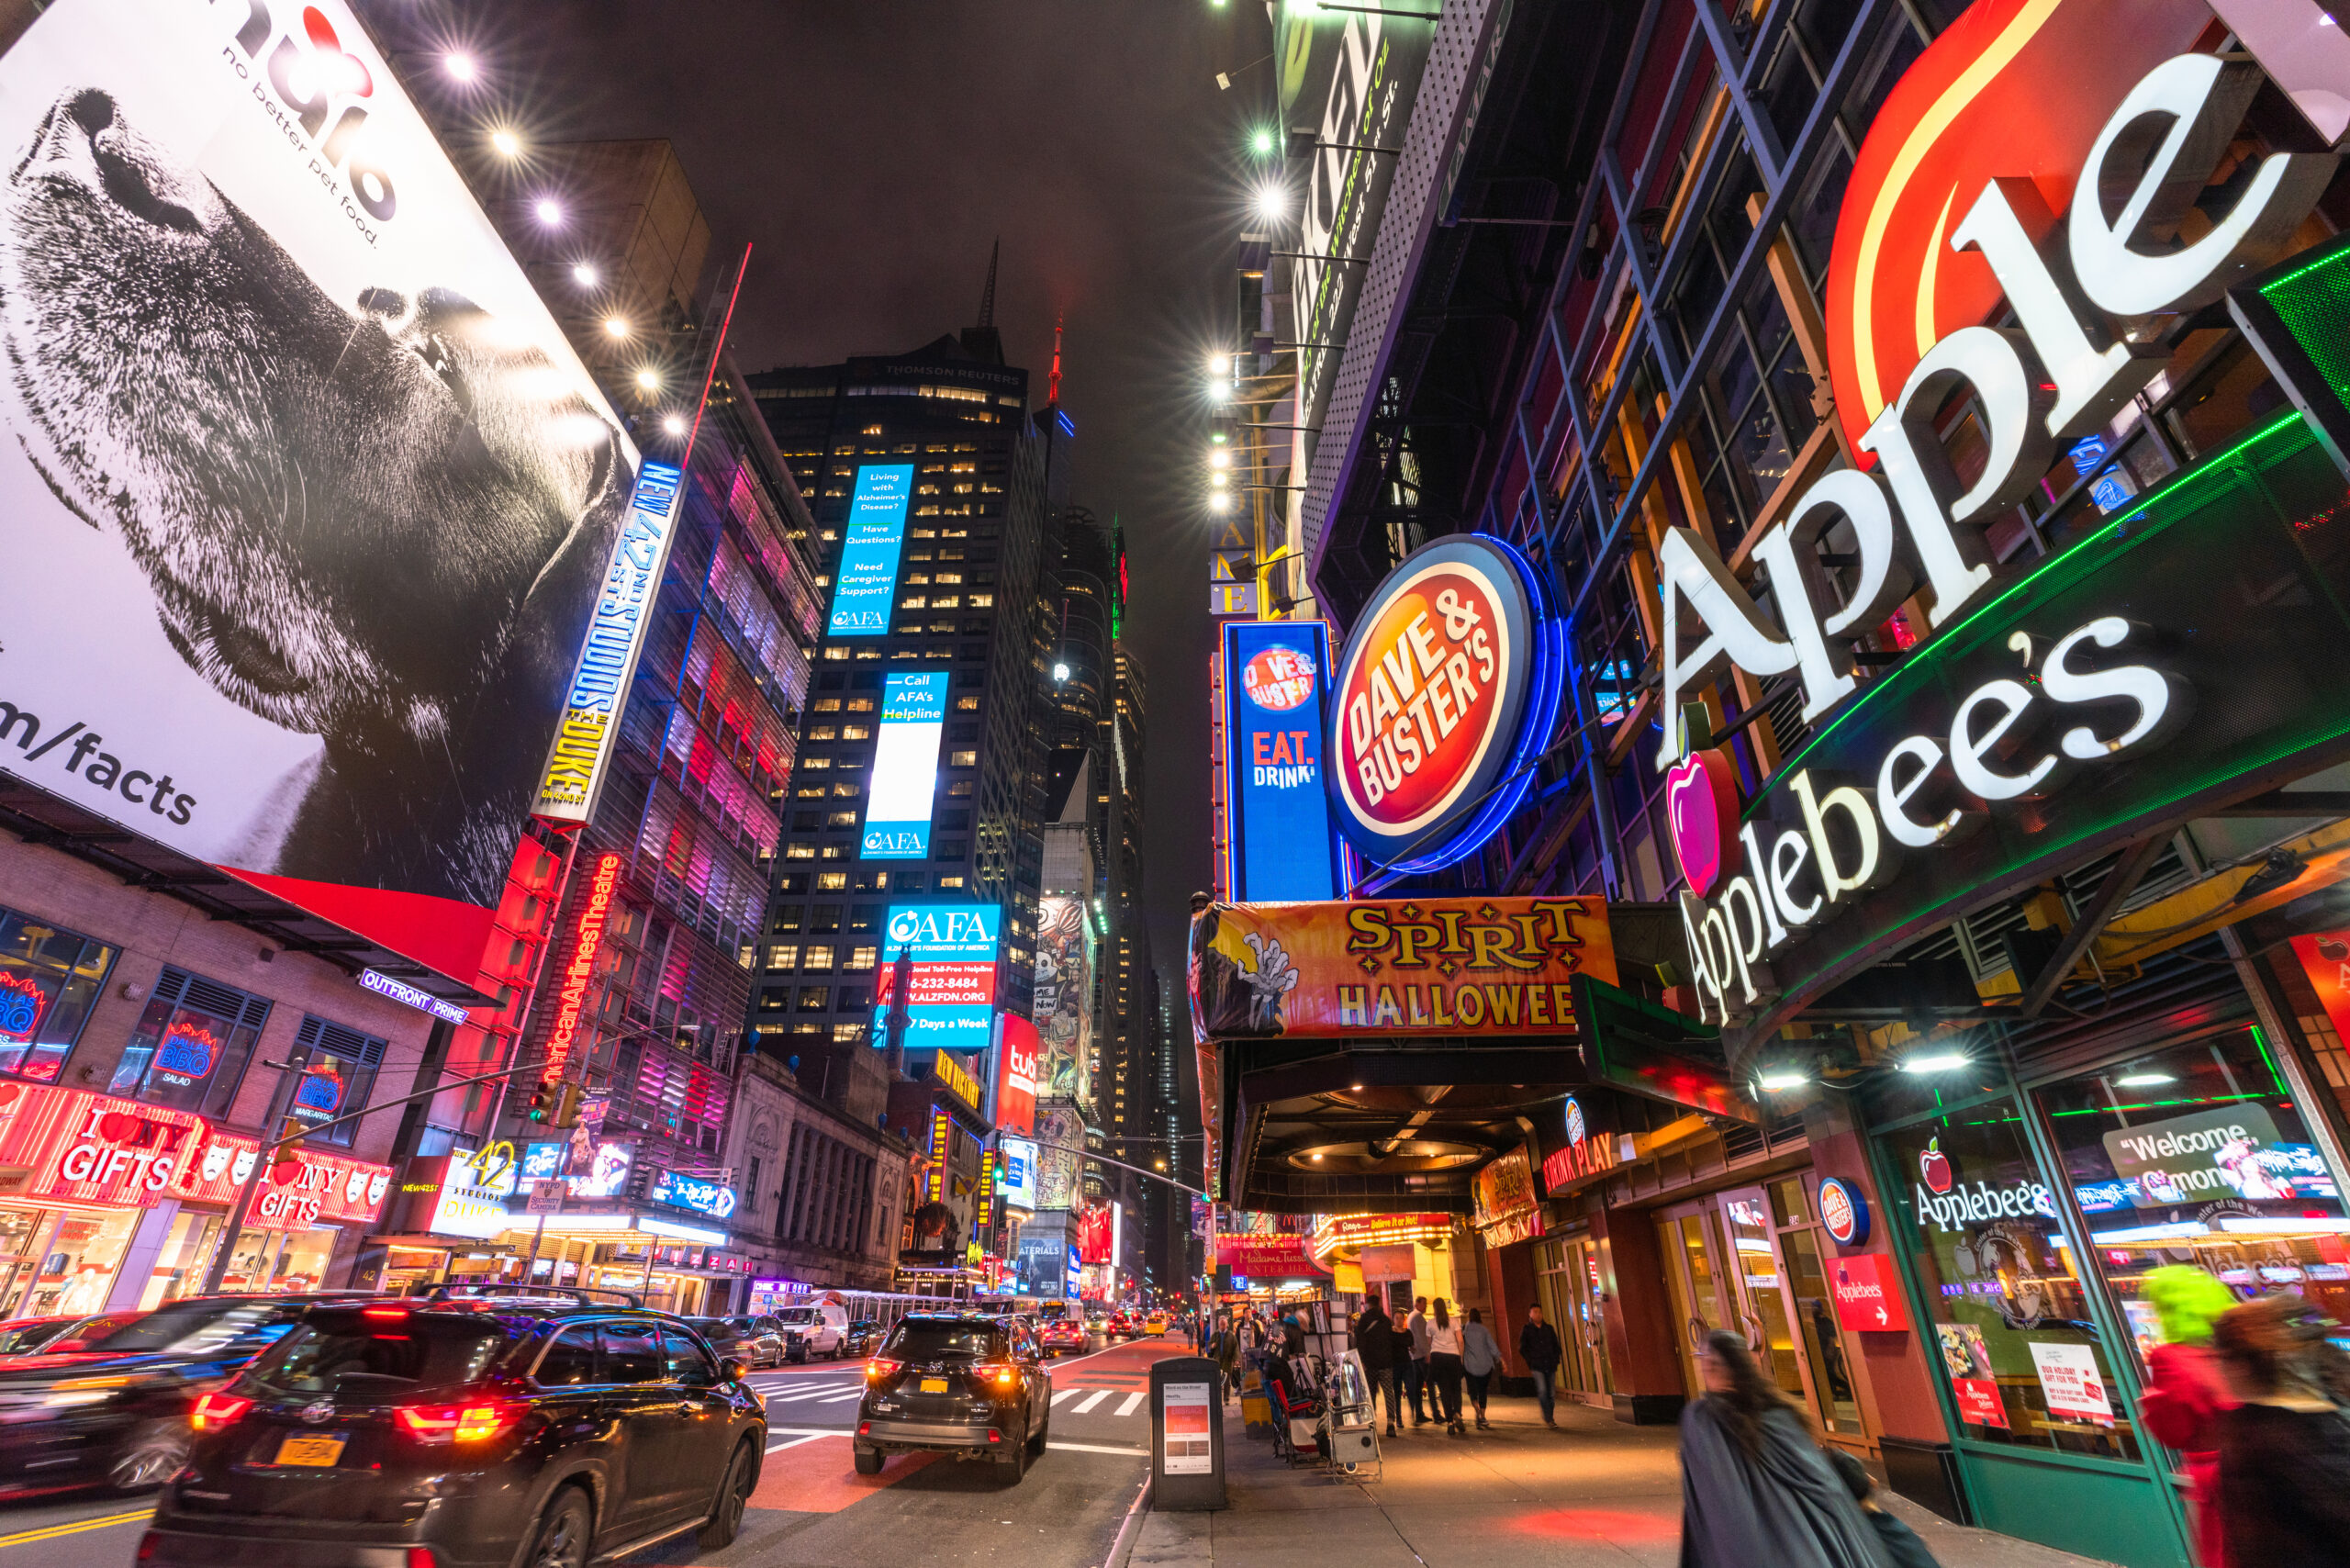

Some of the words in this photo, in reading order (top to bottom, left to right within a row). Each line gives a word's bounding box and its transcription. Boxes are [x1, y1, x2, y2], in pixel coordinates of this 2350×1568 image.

[1448, 23, 1502, 194] LAMAR
[222, 46, 249, 79] no
[252, 82, 308, 152] better
[308, 158, 339, 196] pet
[340, 196, 377, 249] food.
[1319, 264, 1331, 310] the
[1331, 140, 1363, 258] Witches
[1363, 85, 1374, 135] of
[1374, 36, 1390, 89] Oz
[1328, 273, 1344, 330] 222
[1343, 192, 1365, 269] West
[1382, 79, 1398, 129] St.
[887, 365, 955, 376] THOMSON
[957, 367, 1020, 386] REUTERS
[1656, 52, 2292, 773] Apple
[870, 474, 900, 482] Living
[632, 462, 681, 517] NEW
[846, 536, 901, 544] Questions?
[855, 563, 884, 571] Need
[841, 576, 893, 585] Caregiver
[840, 587, 890, 597] Support?
[569, 599, 641, 712] STUDIOS
[904, 675, 931, 686] Call
[1348, 610, 1448, 761] DAVE
[1437, 588, 1483, 642] &
[895, 692, 934, 702] AFA's
[568, 709, 609, 723] THE
[883, 709, 942, 721] Helpline
[1358, 626, 1494, 807] BUSTER'S
[545, 719, 605, 793] DUKE
[1252, 731, 1315, 766] EAT.
[0, 700, 197, 826] m/facts
[542, 789, 553, 799] ON
[554, 790, 575, 802] 42ND
[575, 794, 586, 804] ST
[1679, 616, 2170, 1027] Applebee's
[1348, 900, 1585, 971] SPIRIT
[964, 966, 993, 974] Helpline
[911, 978, 979, 989] 6-232-8484
[0, 989, 37, 1007] LLAS
[364, 972, 431, 1008] OUTFRONT
[433, 1001, 464, 1024] PRIME
[886, 991, 986, 1002] W.ALZFDN.ORG
[1035, 1000, 1056, 1010] NOW
[1338, 983, 1577, 1028] HALLOWEE
[919, 1019, 946, 1030] Days
[957, 1018, 989, 1028] Week
[170, 1036, 211, 1054] DALLAS
[156, 1044, 210, 1076] BBQ
[162, 1073, 191, 1087] SALAD
[307, 1076, 339, 1091] DALLAS
[937, 1048, 954, 1084] NEW
[953, 1063, 979, 1109] VICTORY
[297, 1083, 339, 1111] BBQ
[295, 1107, 334, 1122] MARGARITAS
[130, 1118, 192, 1152] NY
[933, 1114, 947, 1168] VICTORY
[453, 1149, 468, 1159] NEW
[1548, 1146, 1576, 1190] DRINK
[1574, 1132, 1613, 1178] PLAY
[62, 1144, 174, 1192] GIFTS
[468, 1139, 515, 1191] 42
[980, 1151, 993, 1196] VICTORY
[0, 1175, 23, 1186] DWAY
[296, 1162, 345, 1193] NY
[539, 1182, 561, 1190] NYPD
[402, 1183, 440, 1193] NEW42ST
[454, 1187, 501, 1202] STUDIOS
[931, 1174, 941, 1202] NEW
[260, 1192, 321, 1222] GIFTS
[979, 1202, 989, 1224] NEW
[1823, 1192, 1841, 1215] DAVE
[2216, 1199, 2225, 1209] of
[2226, 1199, 2244, 1210] the
[1371, 1219, 1392, 1230] Believe
[1392, 1218, 1397, 1227] It
[1397, 1219, 1404, 1227] or
[1404, 1215, 1418, 1226] Not!
[1828, 1206, 1852, 1230] BUSTER'S
[1994, 1227, 2005, 1238] the
[1019, 1247, 1059, 1255] ATERIALS
[1239, 1249, 1282, 1264] Madame
[362, 1270, 376, 1282] 42
[1247, 1265, 1284, 1273] ENTER
[1289, 1265, 1316, 1273] HER
[1836, 1281, 1882, 1303] Applebee's
[1263, 1342, 1283, 1358] USA
